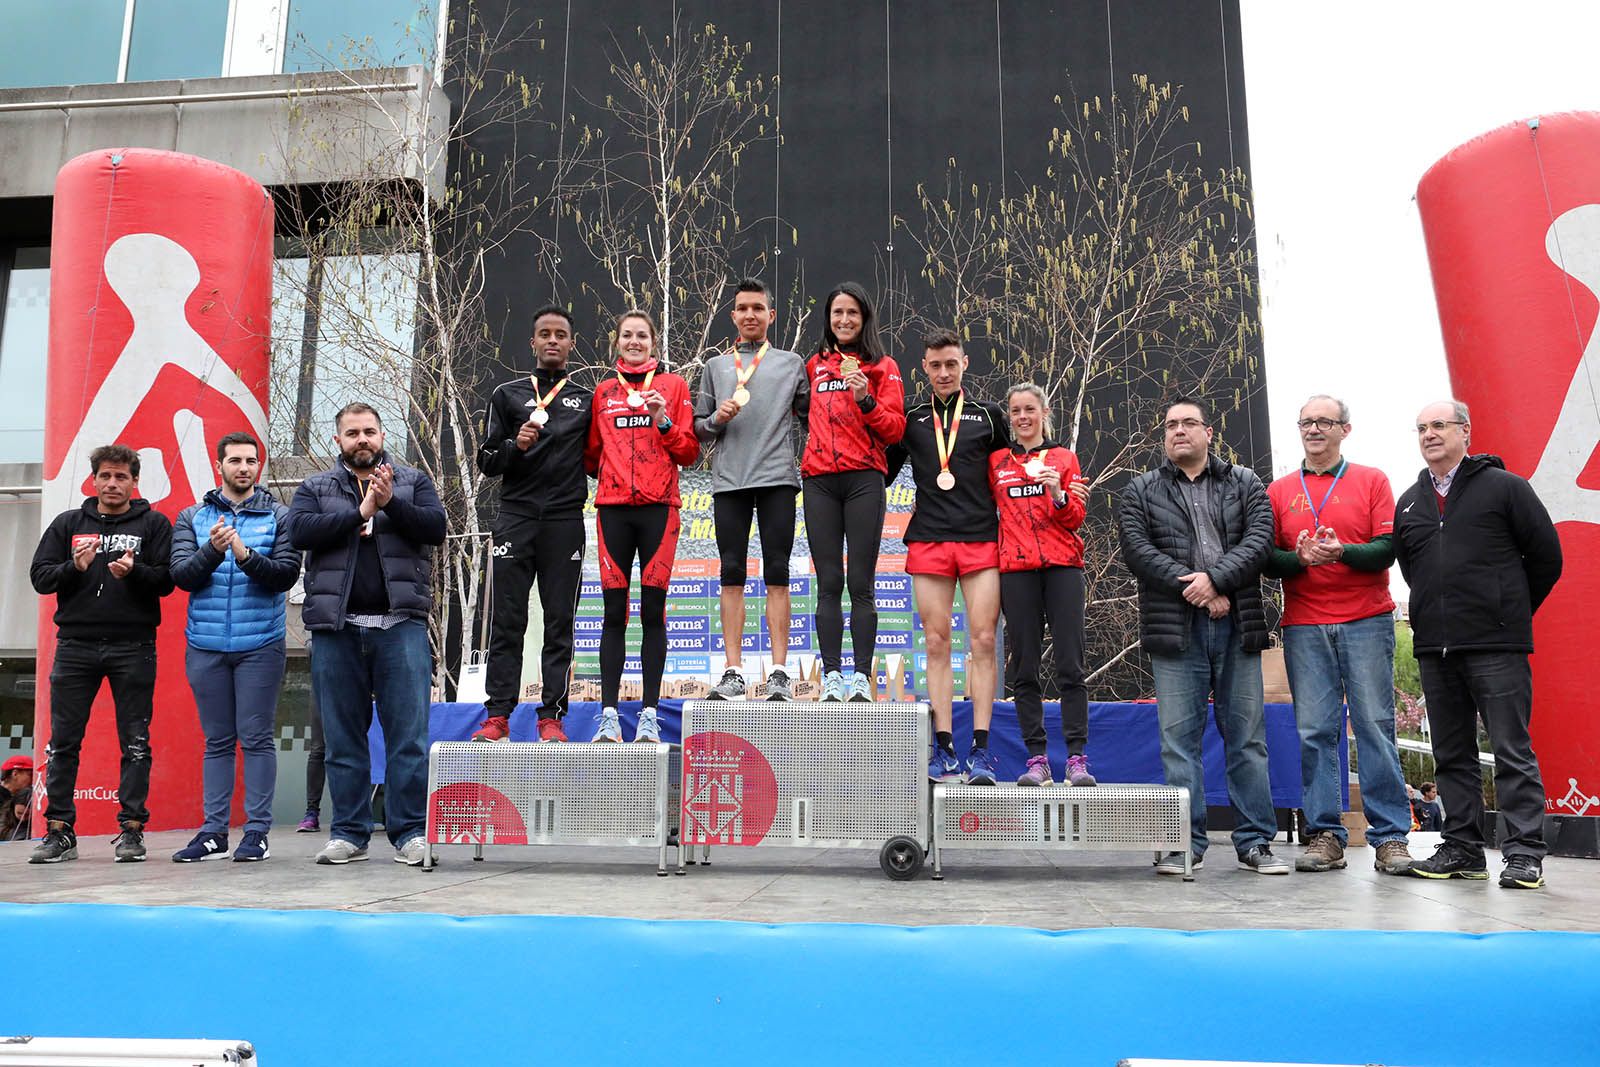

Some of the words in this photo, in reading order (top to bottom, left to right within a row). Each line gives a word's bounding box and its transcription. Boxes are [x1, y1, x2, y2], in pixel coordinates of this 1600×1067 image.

[960, 414, 982, 422] IKILA
[874, 581, 905, 590] oma
[875, 599, 906, 608] oma
[575, 621, 603, 630] oma
[875, 636, 906, 644] oma
